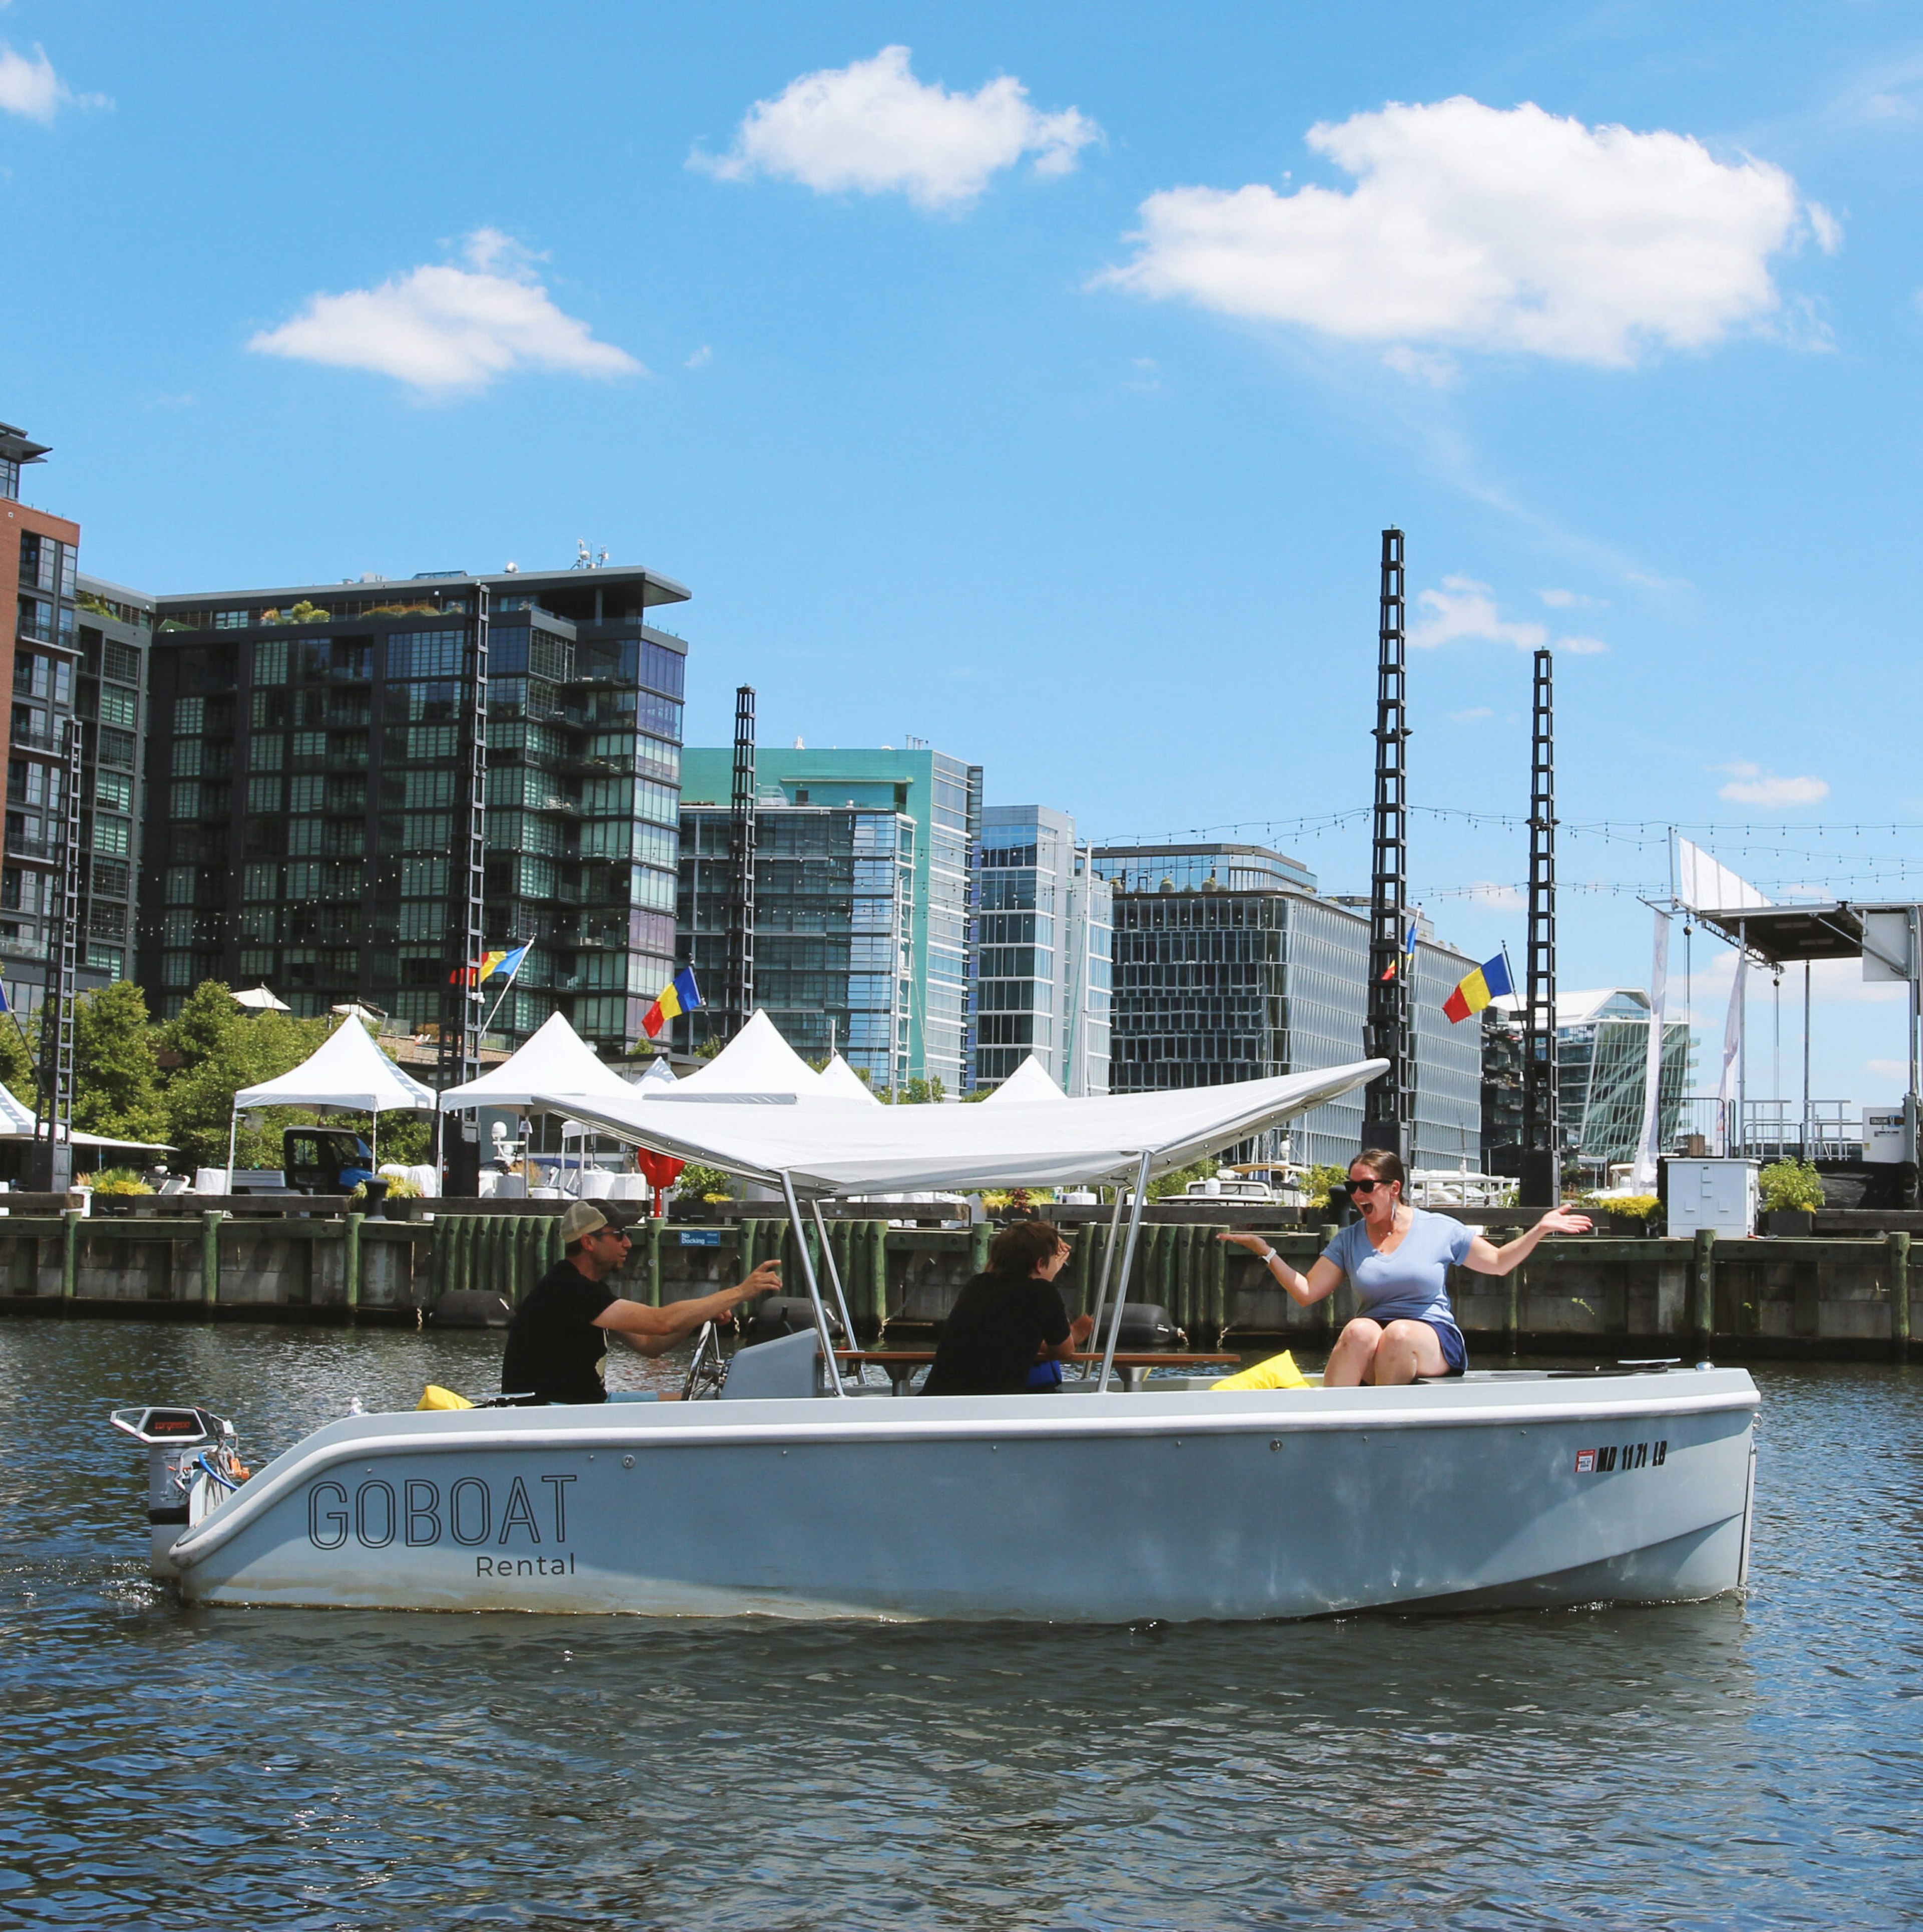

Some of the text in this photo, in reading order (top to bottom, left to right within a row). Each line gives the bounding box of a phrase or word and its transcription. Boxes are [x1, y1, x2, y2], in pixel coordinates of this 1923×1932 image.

[1596, 1446, 1618, 1473] MD
[1652, 1440, 1668, 1467] LB
[308, 1474, 577, 1550] GOBOAT
[476, 1552, 575, 1577] Rental
